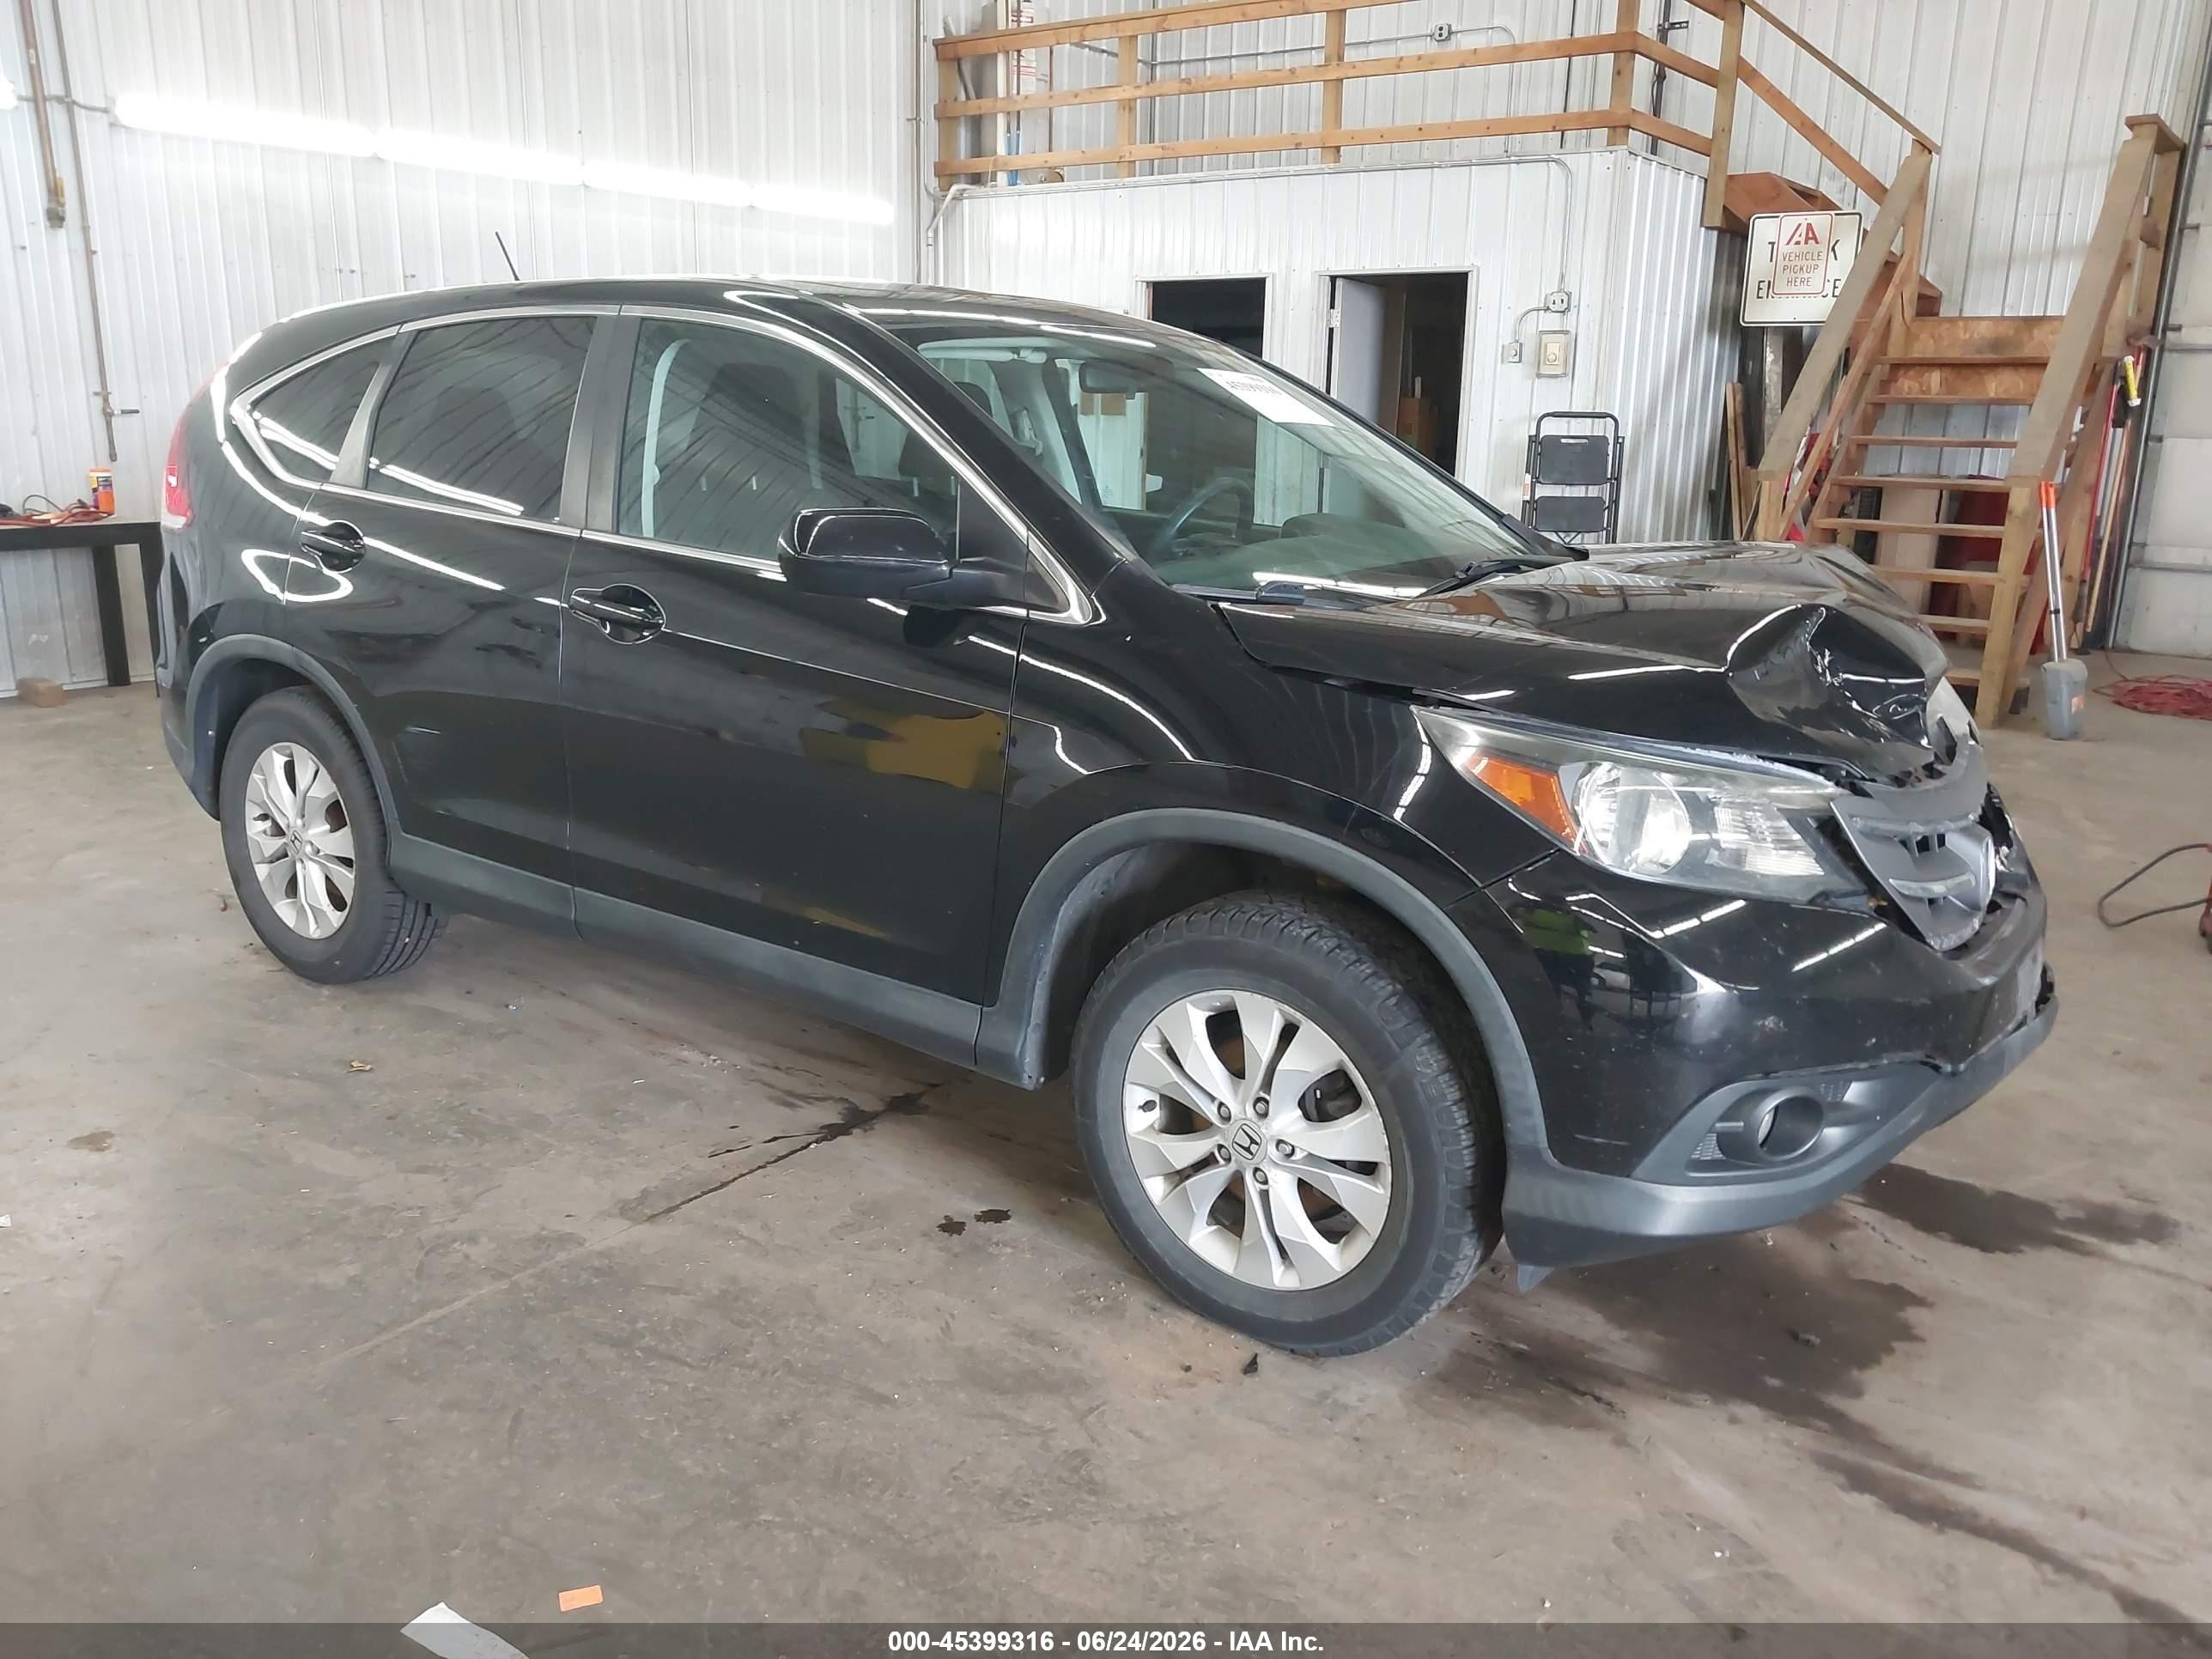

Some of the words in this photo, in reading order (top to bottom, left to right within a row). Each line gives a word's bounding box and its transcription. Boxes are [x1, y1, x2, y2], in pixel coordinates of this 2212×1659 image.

[1782, 251, 1823, 262] VEHICLE
[1782, 264, 1820, 275] PICKUP
[1786, 276, 1813, 287] HERE
